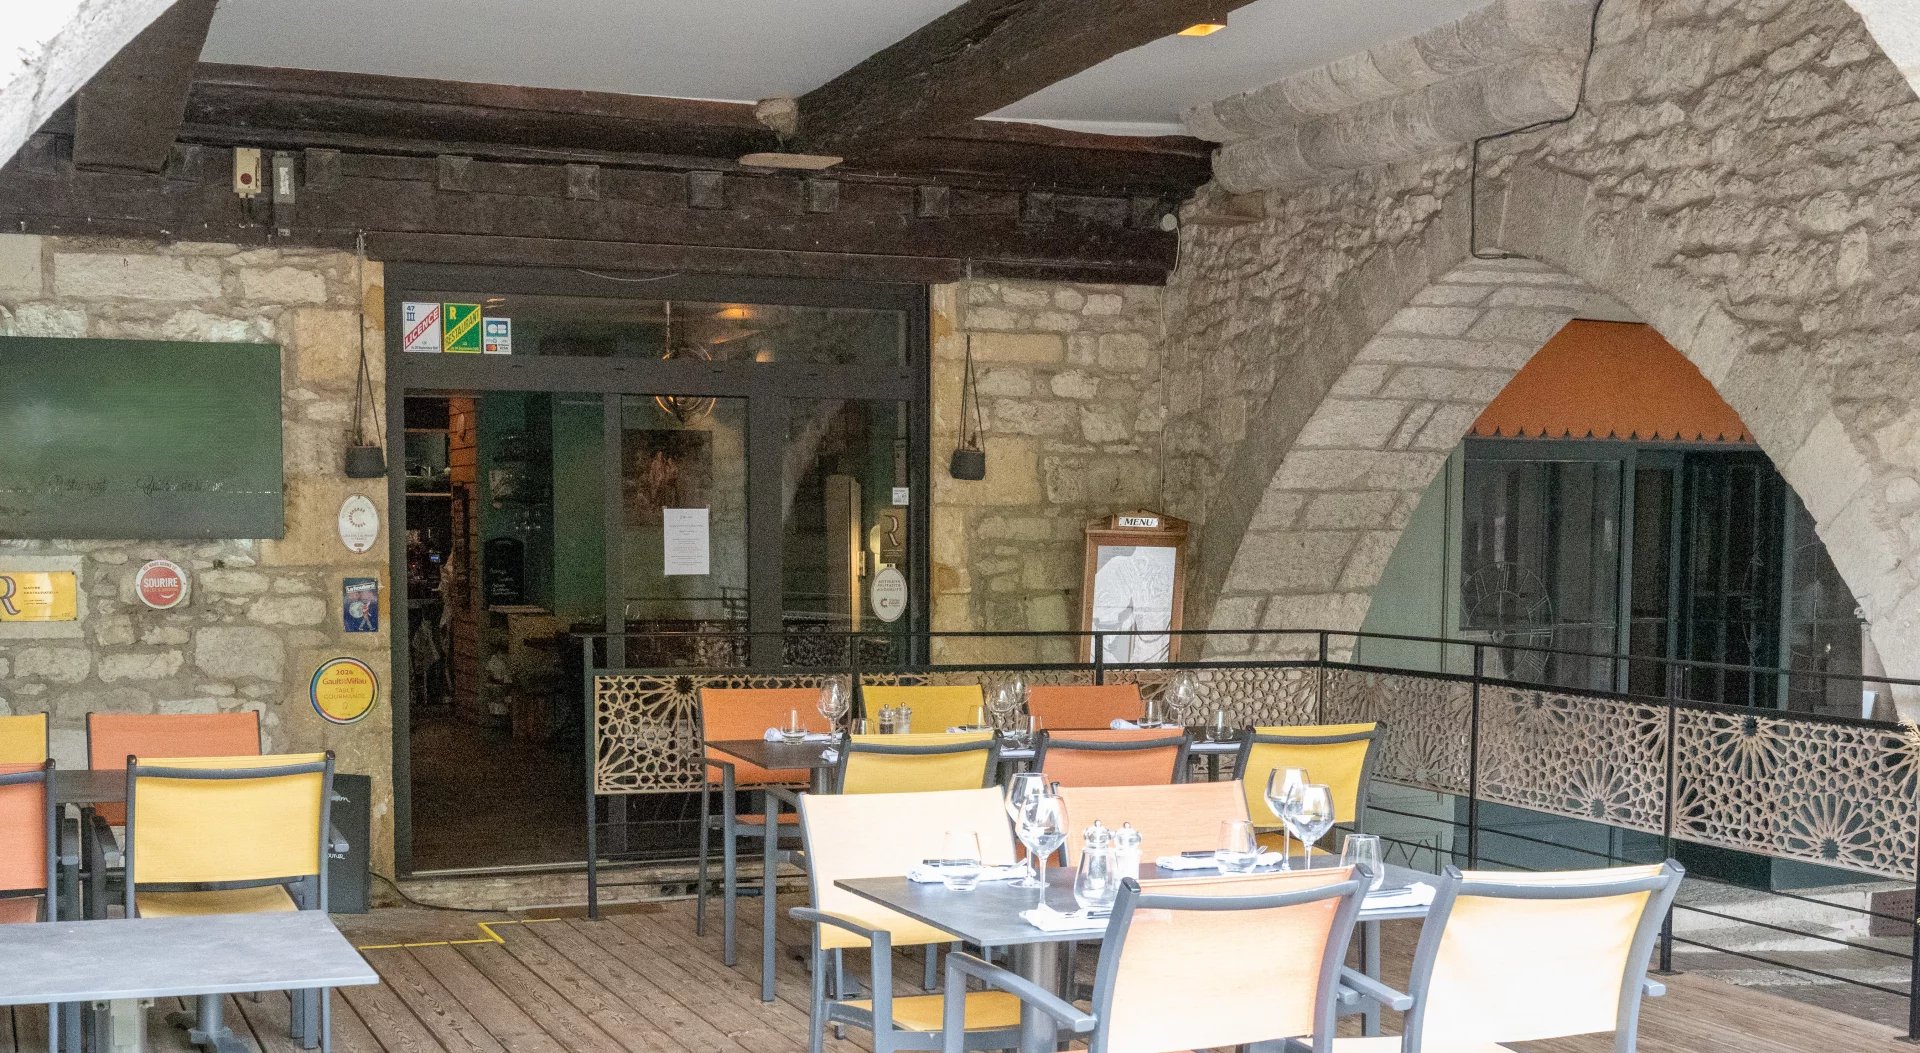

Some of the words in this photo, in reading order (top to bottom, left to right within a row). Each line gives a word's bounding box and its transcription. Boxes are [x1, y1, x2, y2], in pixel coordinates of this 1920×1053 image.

[449, 306, 457, 320] R
[404, 308, 440, 346] LICENCE
[446, 309, 480, 345] RESTAURANT
[1124, 518, 1155, 526] MENU
[143, 577, 179, 588] SOURIRE
